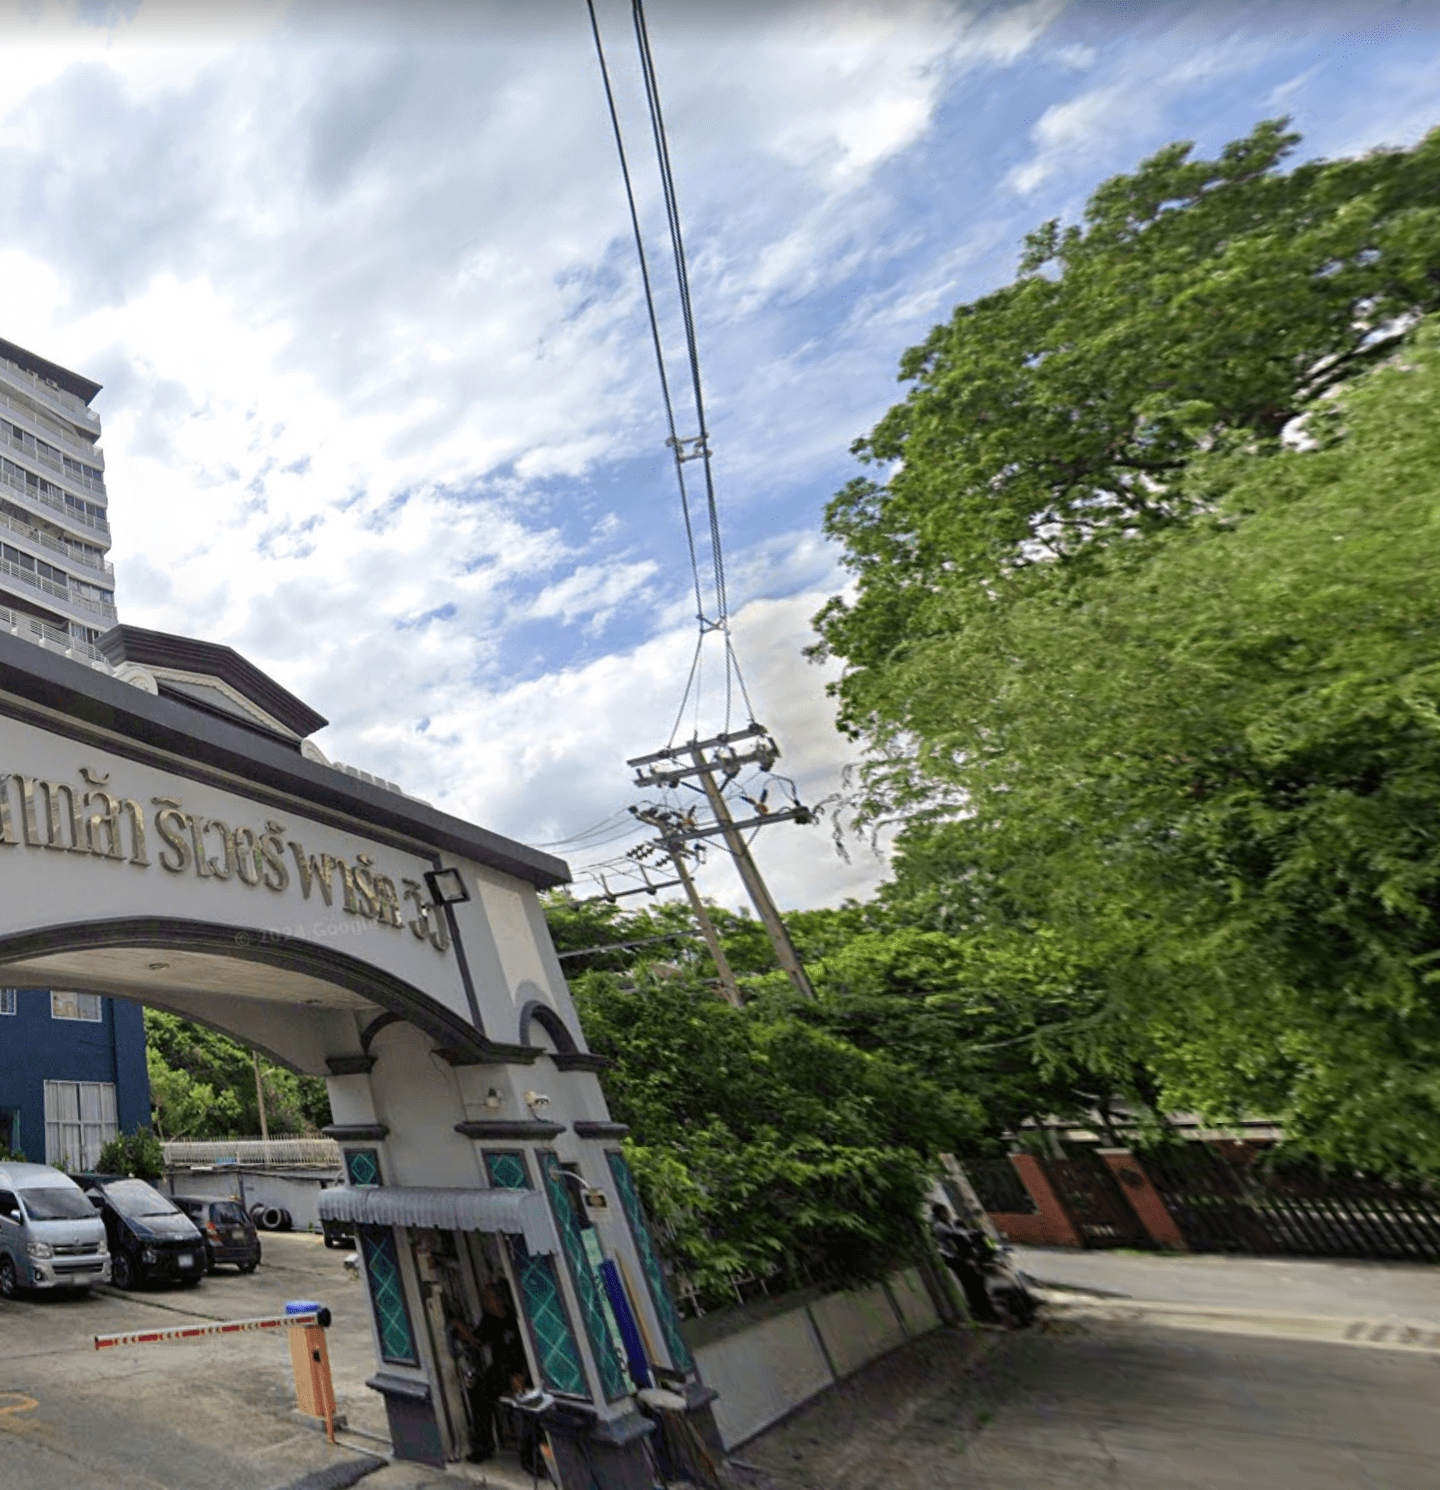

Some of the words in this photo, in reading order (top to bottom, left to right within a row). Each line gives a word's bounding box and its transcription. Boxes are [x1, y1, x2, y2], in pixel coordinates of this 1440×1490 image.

[150, 796, 289, 892] ริเวอร์
[288, 841, 405, 929] พาร์ค
